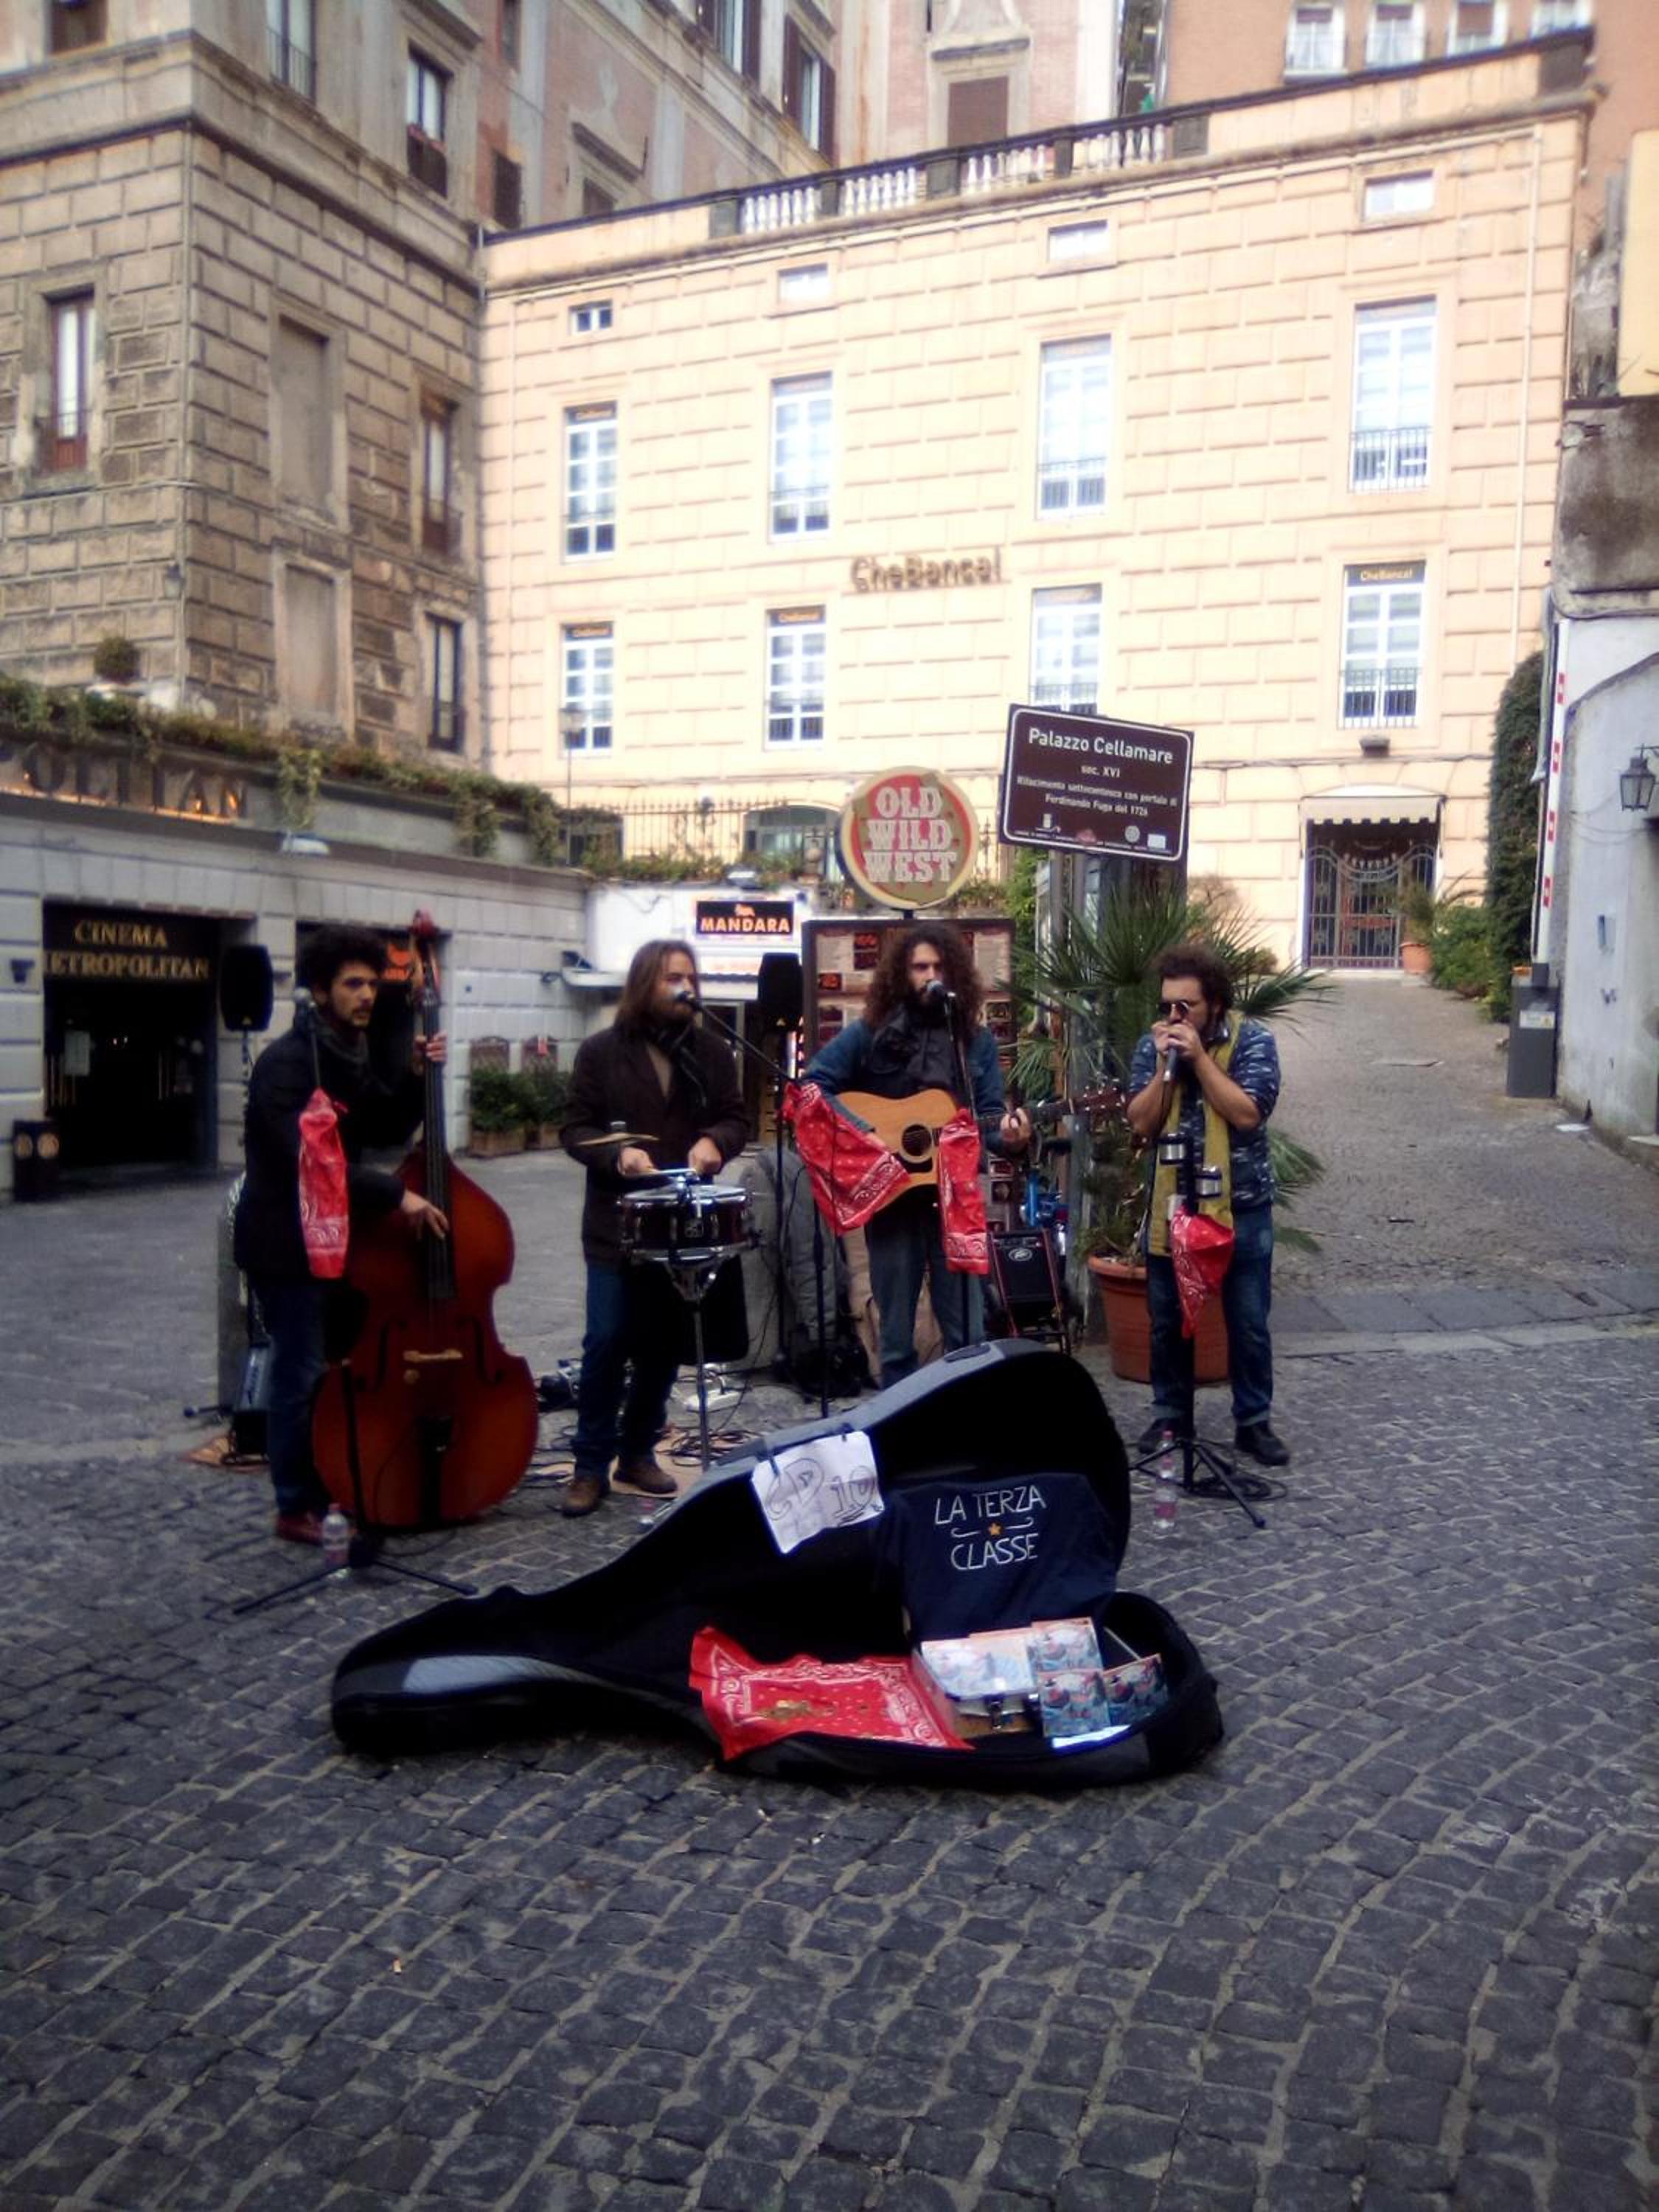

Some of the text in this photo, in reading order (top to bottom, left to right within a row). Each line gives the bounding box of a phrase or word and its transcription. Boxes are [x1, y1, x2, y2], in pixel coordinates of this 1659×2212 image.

[1029, 727, 1174, 764] Palazzo Cellamare
[1103, 766, 1120, 778] XVI
[875, 786, 943, 818] OLD
[1114, 804, 1127, 814] del
[866, 818, 953, 850] WILD
[862, 851, 956, 883] WEST
[74, 920, 169, 948] CINEMA
[700, 917, 790, 933] MANDARA
[934, 1484, 1047, 1525] LA TERZA
[950, 1533, 1039, 1571] CLASSE
